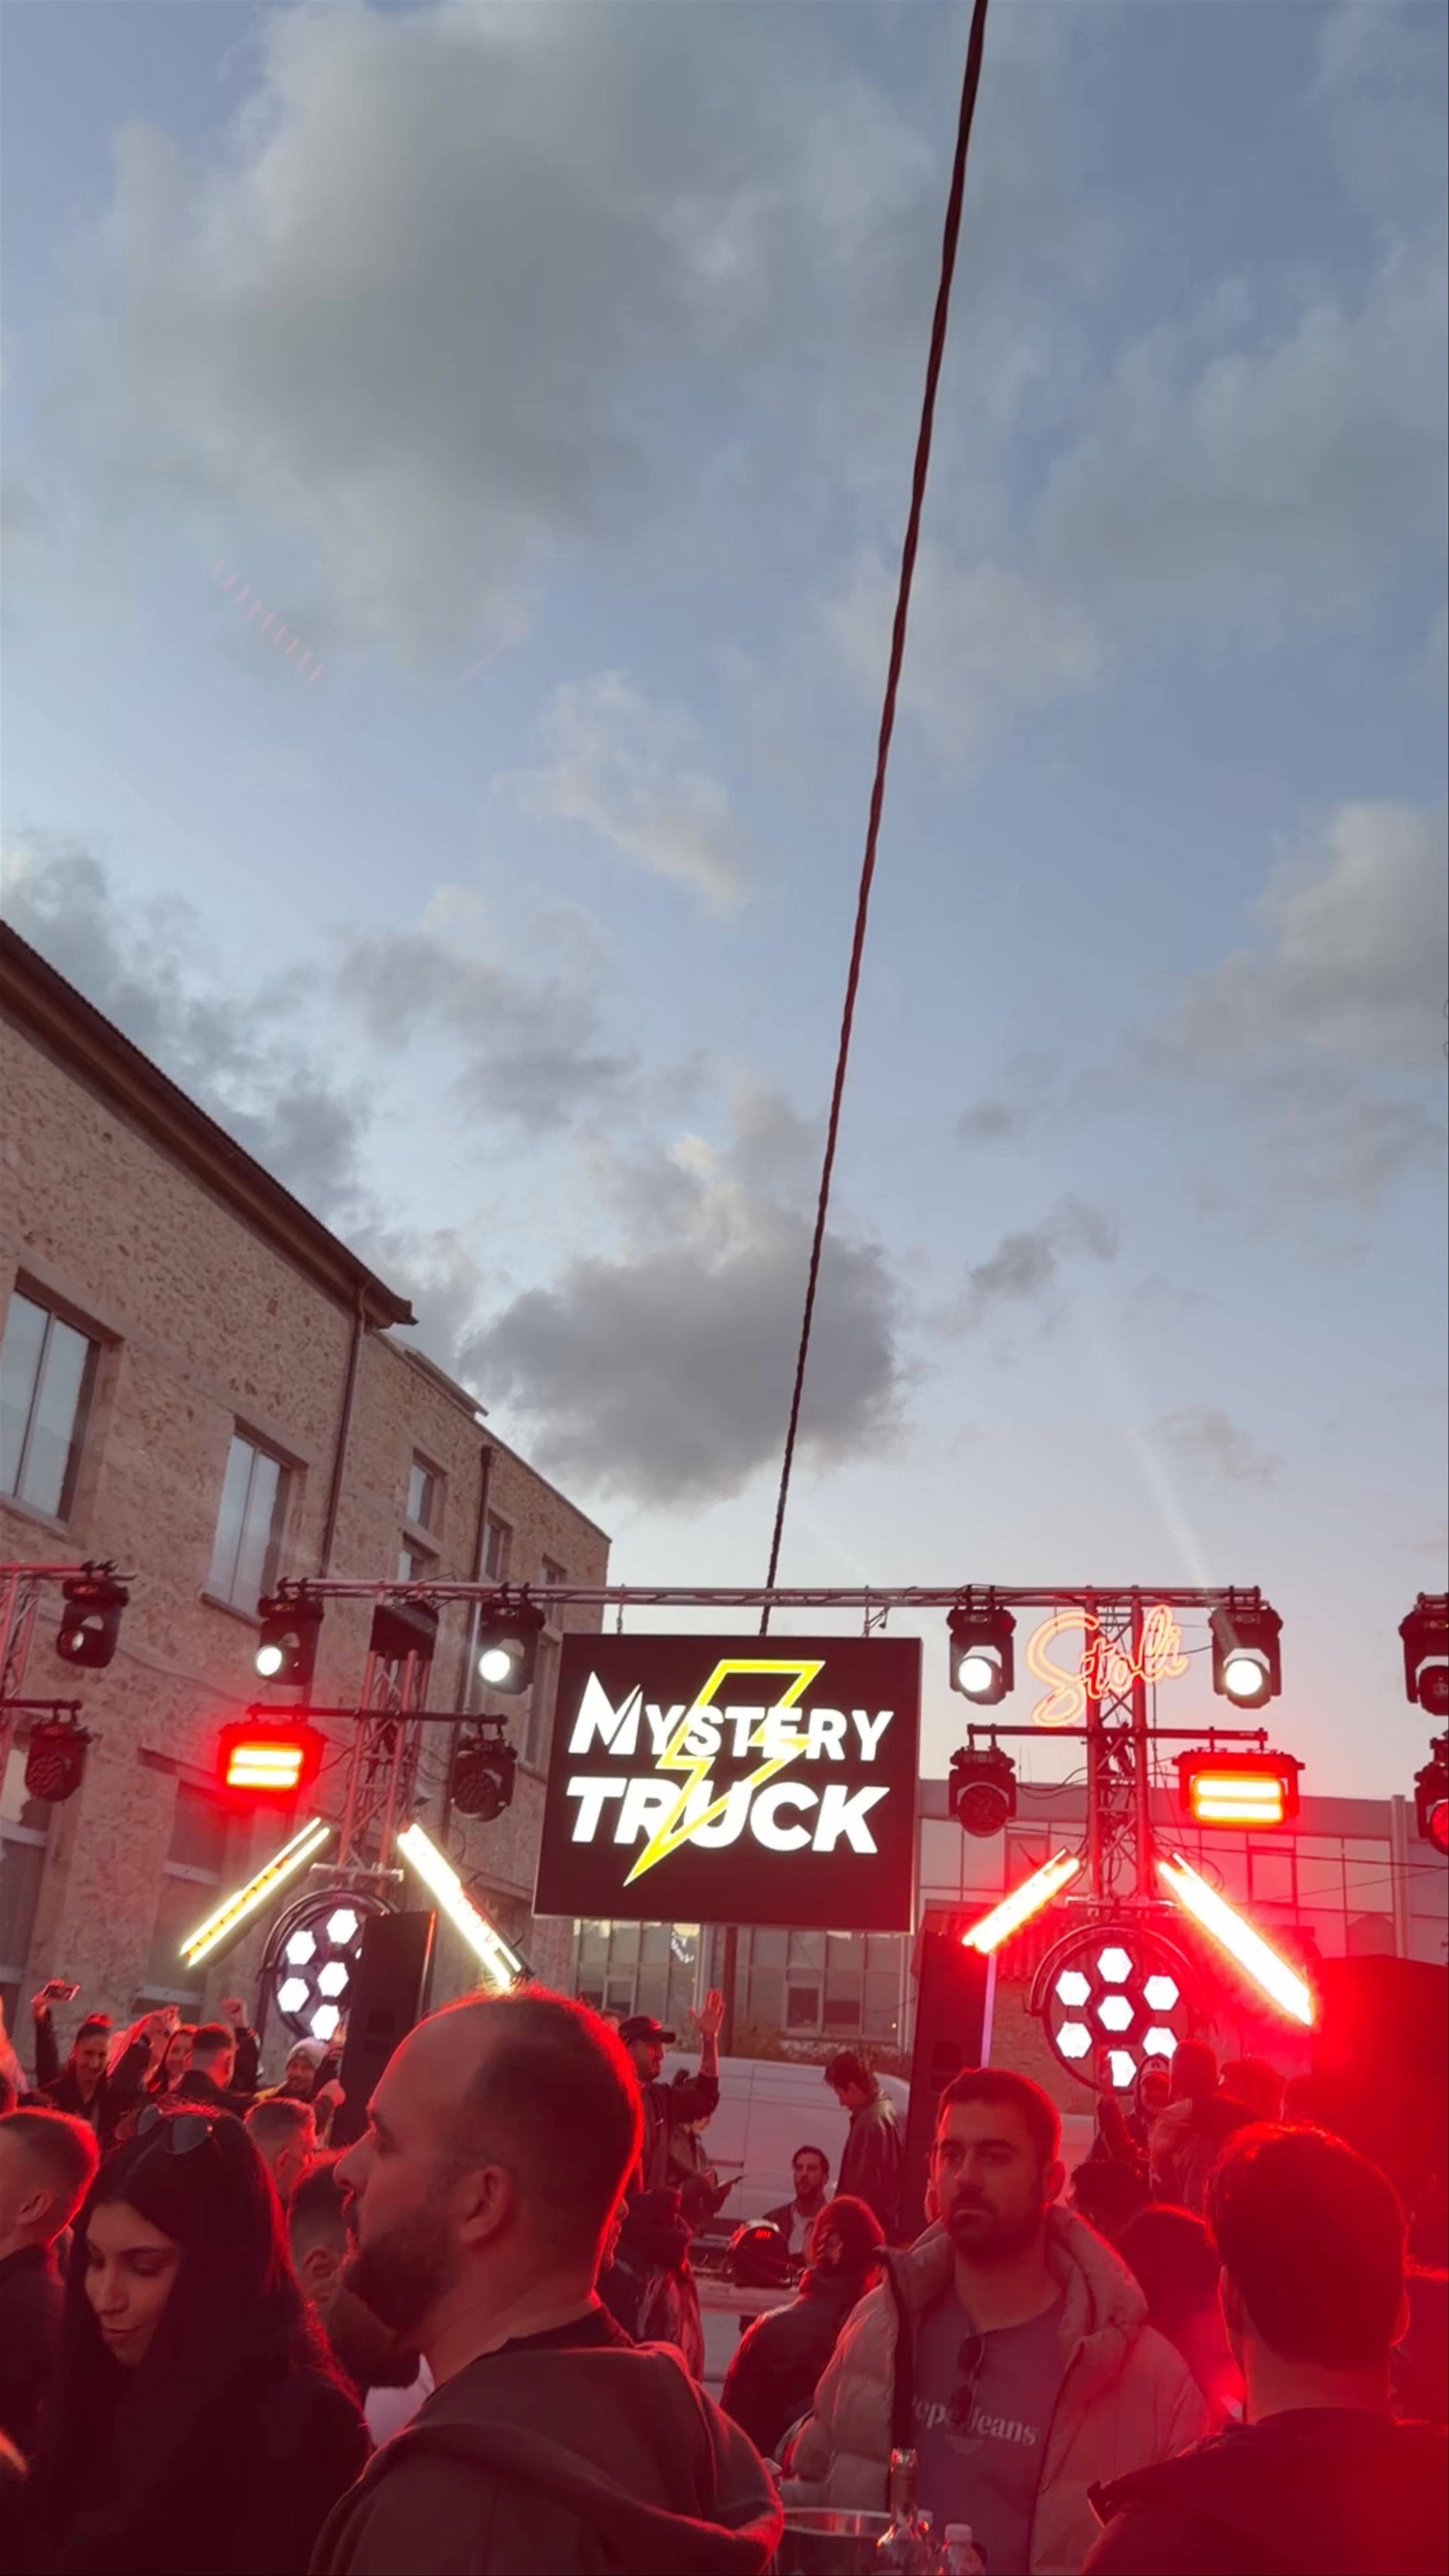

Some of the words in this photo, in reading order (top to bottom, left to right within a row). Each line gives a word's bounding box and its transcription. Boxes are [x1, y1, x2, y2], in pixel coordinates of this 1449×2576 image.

[1027, 1604, 1189, 1727] Stoli
[568, 1672, 894, 1761] MYSTERY
[566, 1776, 890, 1853] TRUCK
